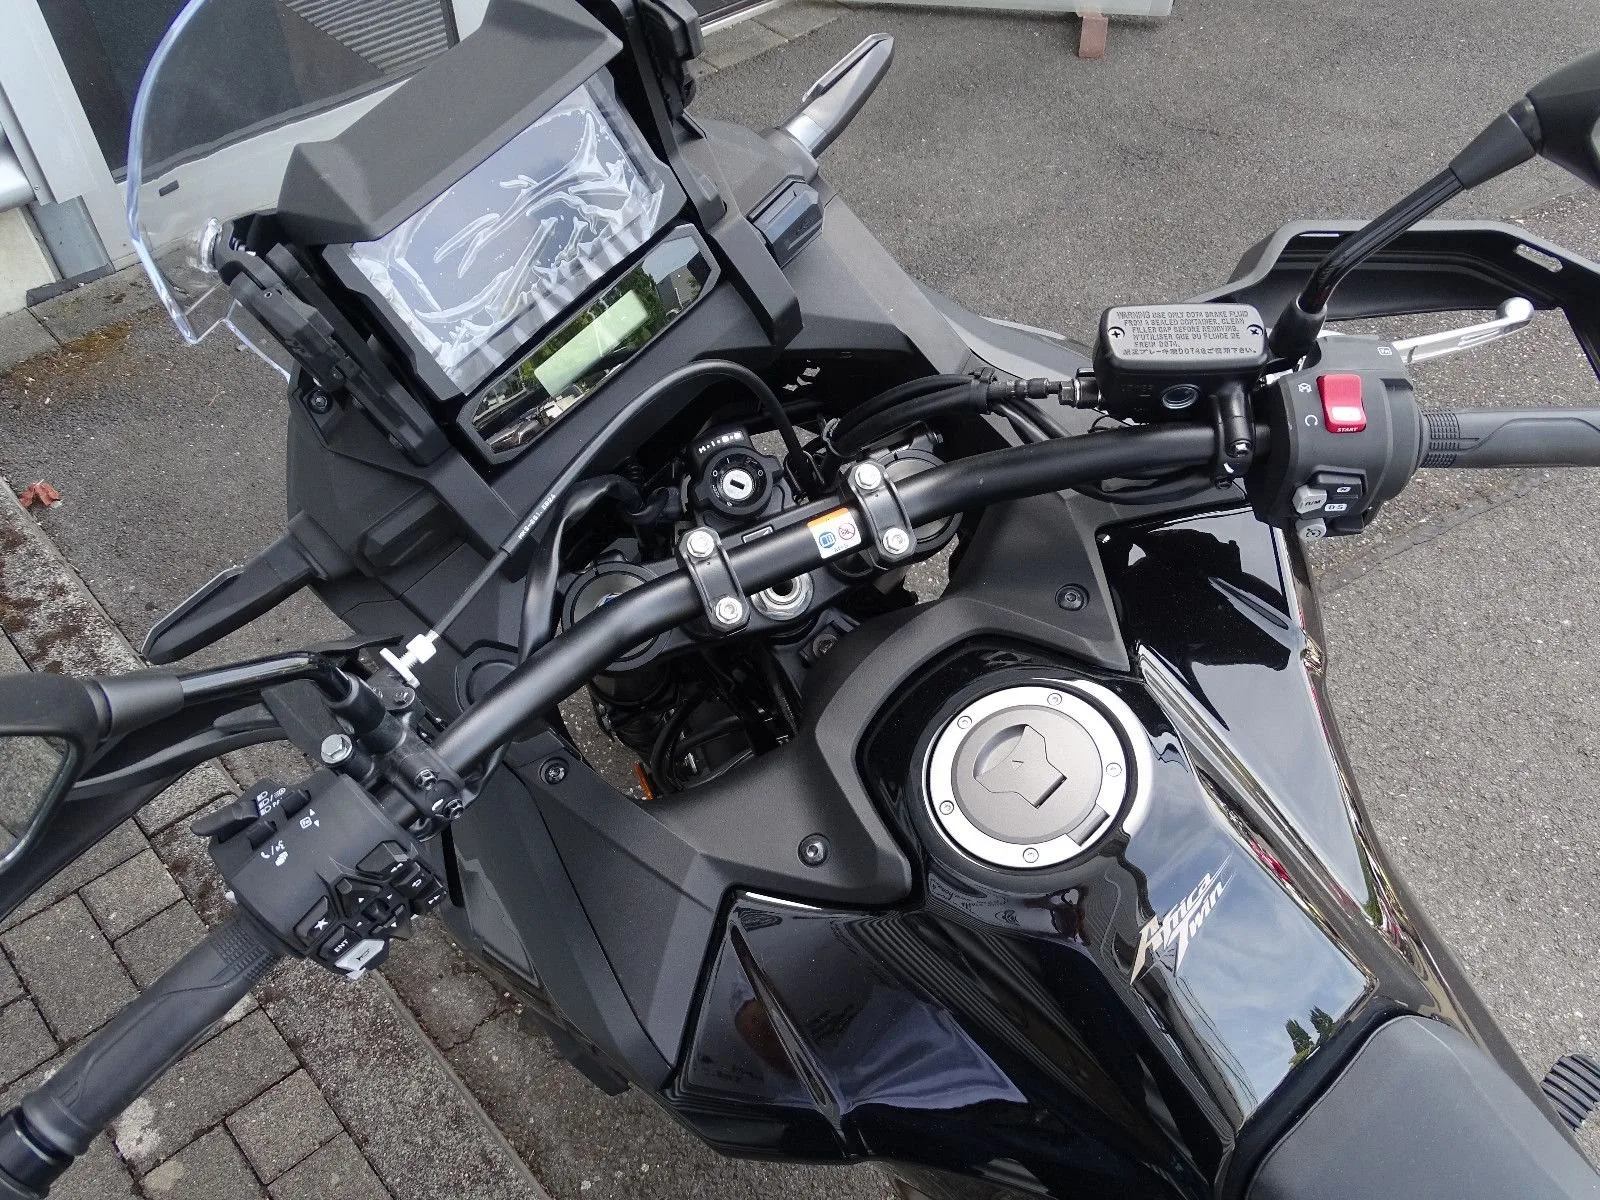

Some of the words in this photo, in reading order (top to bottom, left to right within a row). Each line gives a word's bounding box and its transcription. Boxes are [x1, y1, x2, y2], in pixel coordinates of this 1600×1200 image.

[1116, 311, 1151, 319] WARNING
[333, 938, 349, 953] ENT
[1130, 872, 1212, 985] Africa
[1167, 881, 1224, 973] Twin
